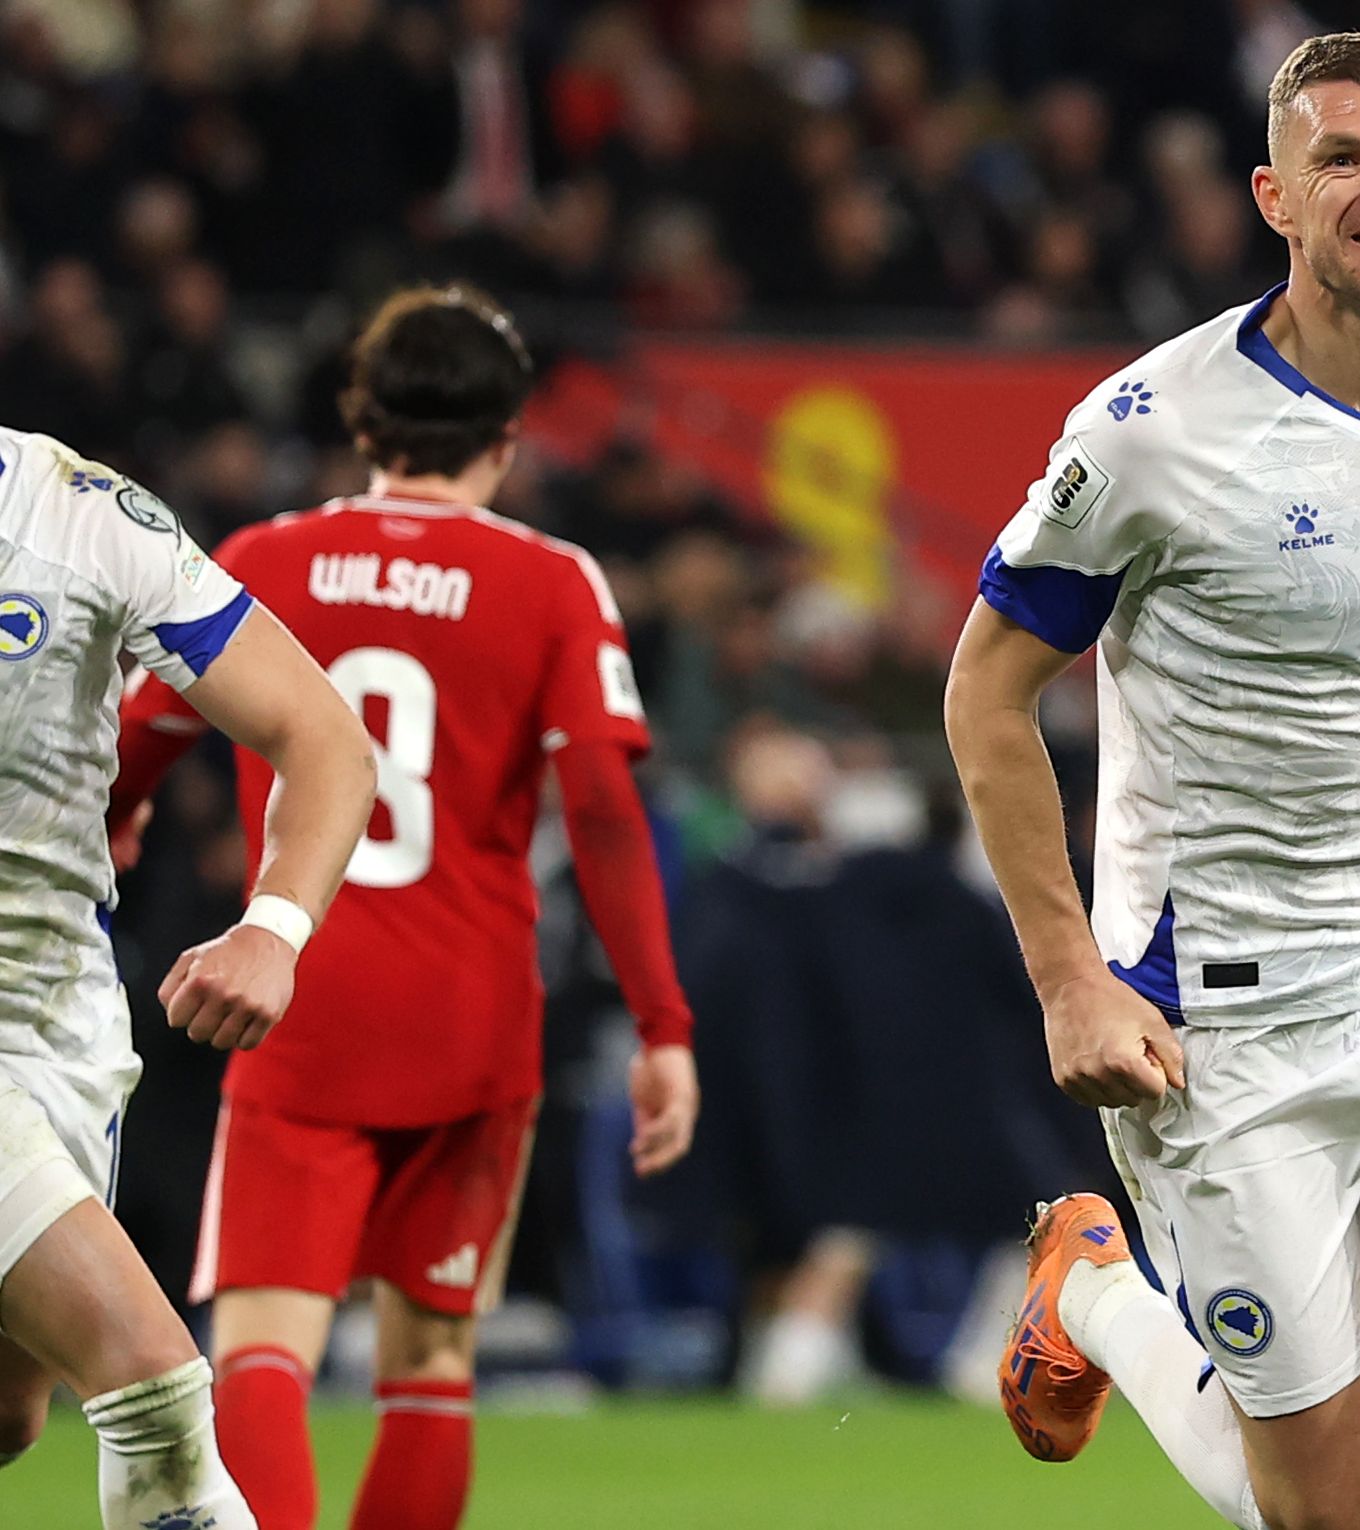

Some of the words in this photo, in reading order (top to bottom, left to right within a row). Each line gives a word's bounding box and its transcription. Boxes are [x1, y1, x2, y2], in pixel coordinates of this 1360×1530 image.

[1278, 534, 1335, 552] KELME
[308, 552, 473, 622] WILSON
[327, 645, 437, 888] 8
